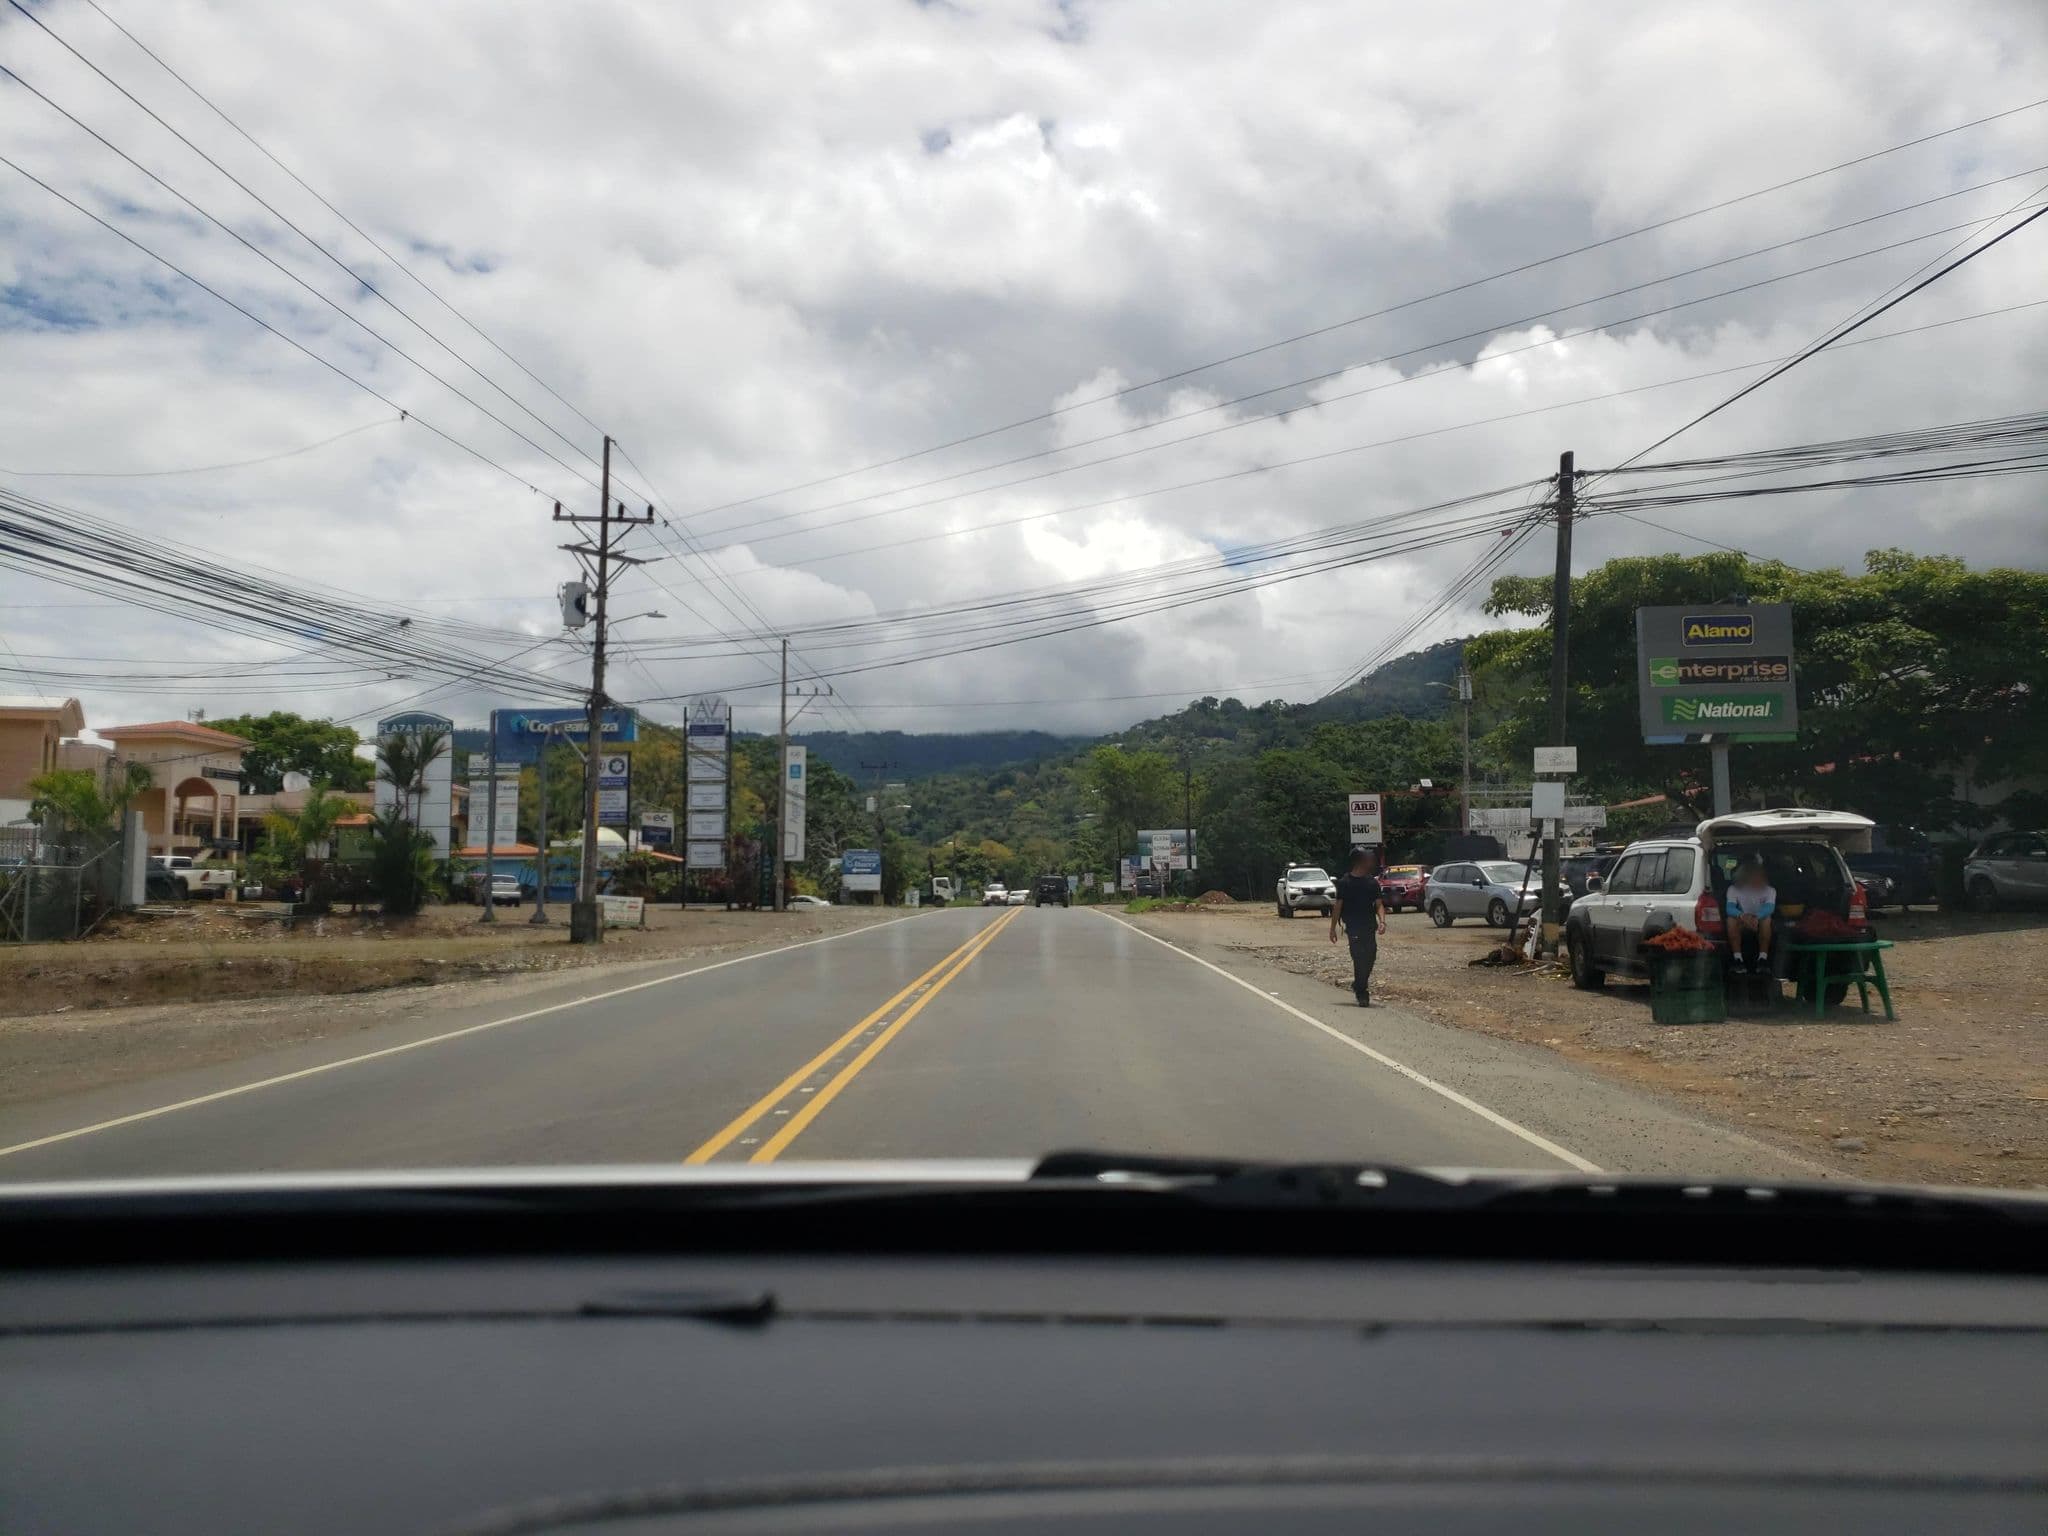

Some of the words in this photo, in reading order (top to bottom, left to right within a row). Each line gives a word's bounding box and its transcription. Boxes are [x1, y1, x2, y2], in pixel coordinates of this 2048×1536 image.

[1688, 624, 1750, 638] Alamo
[1659, 661, 1787, 680] enterprise
[1698, 701, 1771, 718] National
[379, 723, 414, 734] PLAZA
[1354, 803, 1376, 811] ARB
